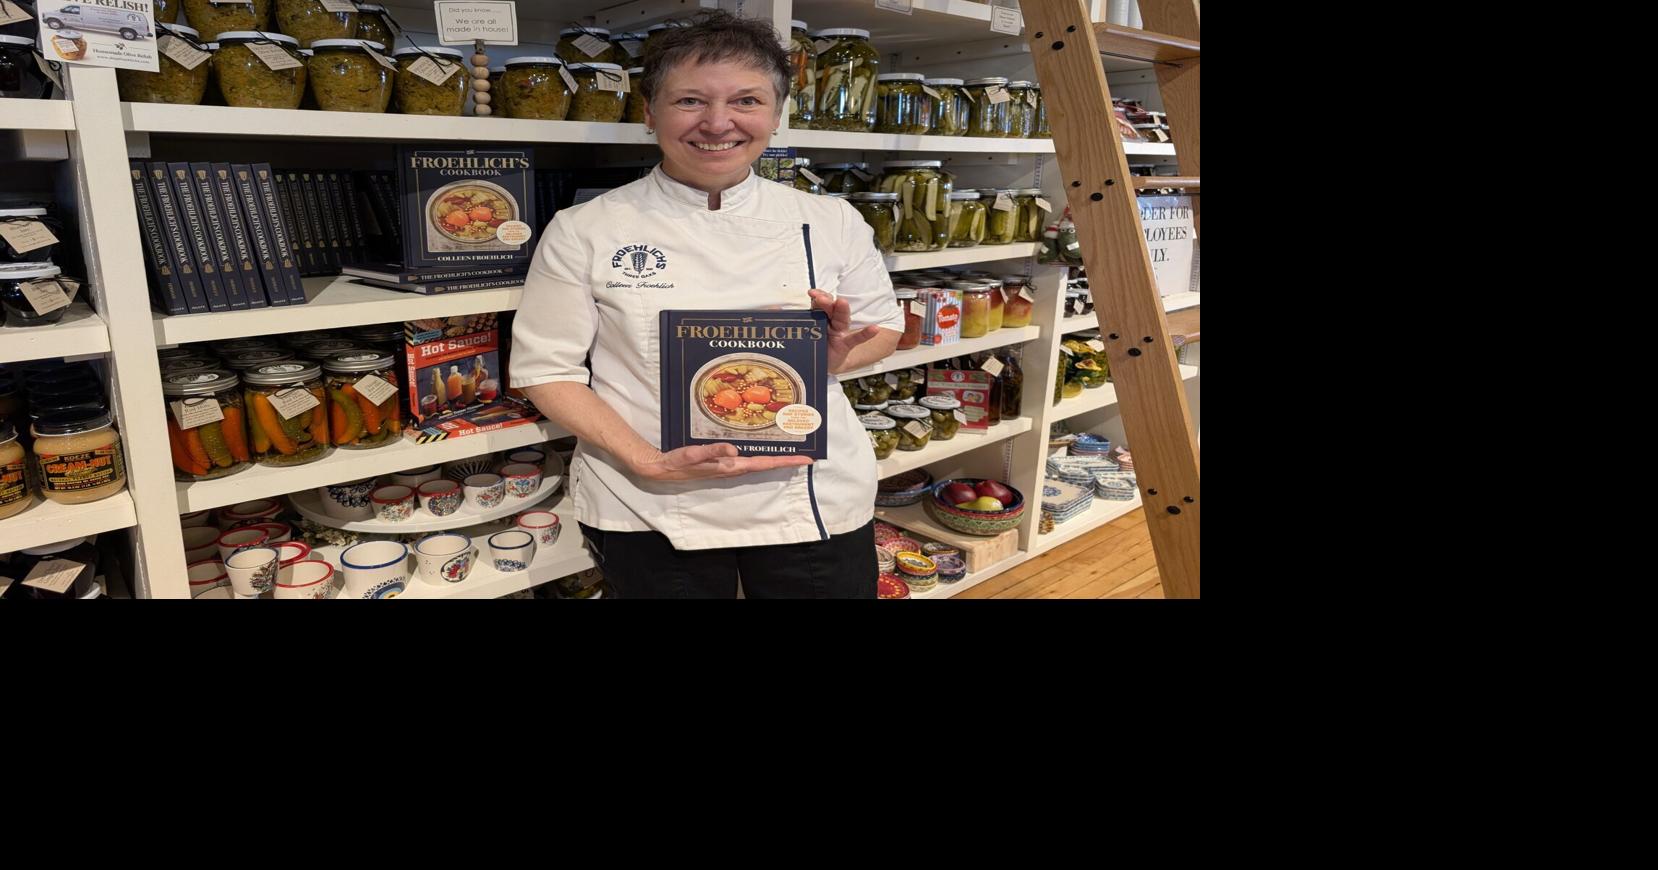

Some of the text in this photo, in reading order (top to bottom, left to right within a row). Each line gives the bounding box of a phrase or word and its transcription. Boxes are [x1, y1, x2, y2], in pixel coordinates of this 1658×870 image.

[94, 0, 149, 13] RELISH!
[410, 157, 530, 168] FROEHLICH'S
[135, 183, 145, 194] THE
[157, 182, 168, 194] THE
[180, 182, 190, 193] THE
[201, 182, 210, 193] THE
[221, 182, 231, 193] THE
[242, 183, 252, 194] THE
[262, 182, 272, 193] THE
[1170, 206, 1189, 220] FOR
[676, 326, 823, 340] FROEHLICH'S
[421, 343, 445, 357] Hot
[448, 332, 492, 350] Sauce!
[709, 340, 785, 349] COOKBOOK
[407, 353, 415, 365] Hot
[459, 423, 503, 436] Hot Sauce!
